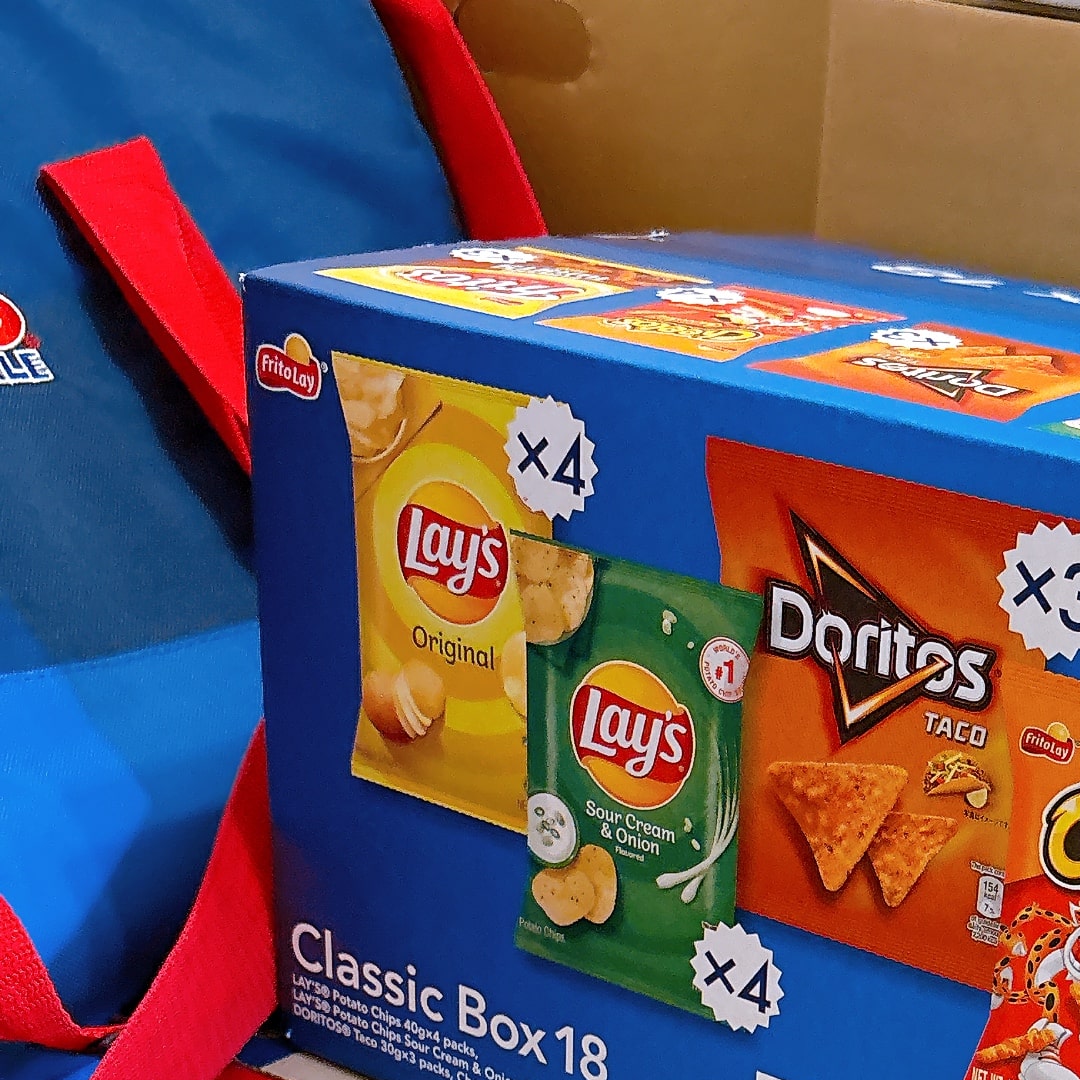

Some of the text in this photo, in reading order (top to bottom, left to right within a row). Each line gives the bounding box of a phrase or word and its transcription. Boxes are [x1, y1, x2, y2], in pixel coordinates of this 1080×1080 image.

[850, 357, 1020, 397] Doritos
[404, 507, 503, 594] Lay's
[412, 625, 495, 671] Original
[769, 585, 994, 703] Doritos
[714, 659, 734, 684] #1
[579, 688, 687, 777] Lay's
[923, 711, 989, 749] TACO
[585, 800, 676, 844] Sour Cream
[600, 822, 660, 856] & Onion
[614, 845, 645, 863] Flavored
[983, 881, 999, 893] 154
[291, 923, 444, 1022] Classic
[332, 989, 369, 1014] Potato
[370, 1005, 402, 1028] Chips
[443, 1036, 479, 1060] packs,
[333, 1004, 369, 1030] Potato
[370, 1021, 402, 1044] Chips
[404, 1034, 430, 1054] Sour
[432, 1046, 469, 1071] Cream
[472, 1061, 482, 1076] &
[353, 1028, 378, 1048] Taco
